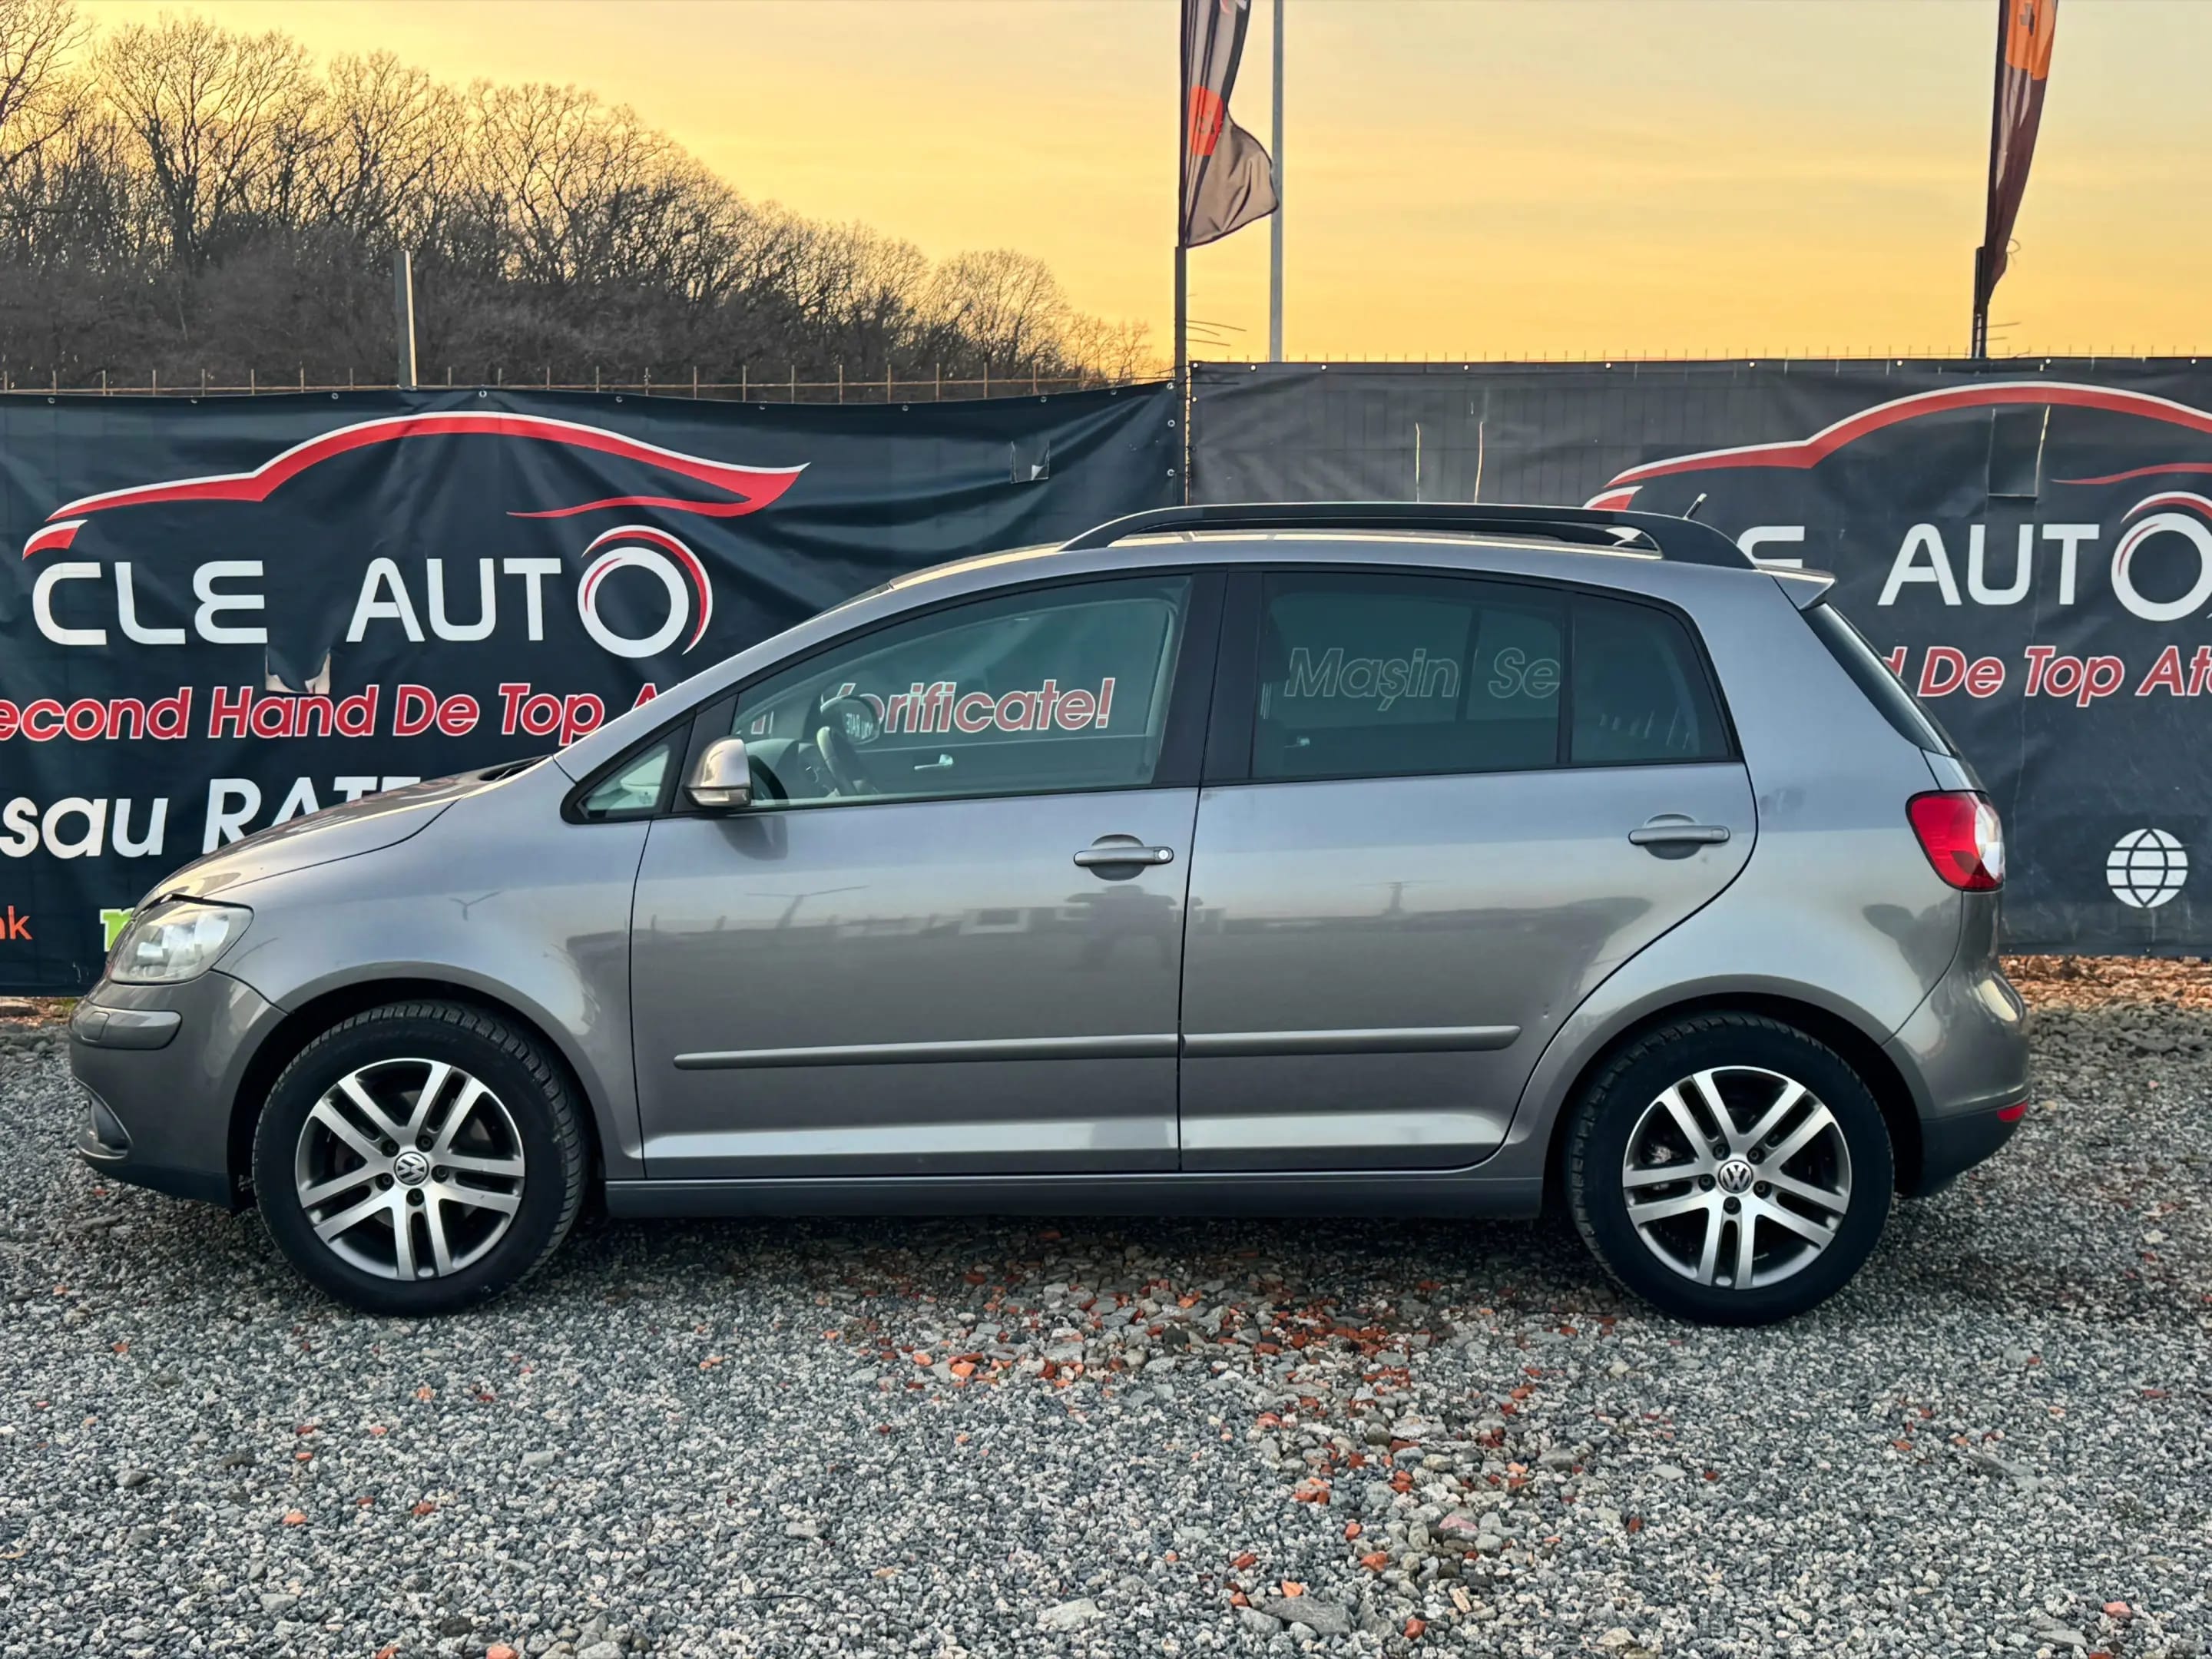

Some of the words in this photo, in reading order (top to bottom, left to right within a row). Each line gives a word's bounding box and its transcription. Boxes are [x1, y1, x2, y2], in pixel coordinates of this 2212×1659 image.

[1878, 512, 2212, 621] AUTO
[32, 561, 267, 646] CLE
[346, 546, 690, 658] AUTO
[1918, 646, 2005, 698] De
[2025, 645, 2125, 707] Top
[2134, 645, 2212, 697] At
[207, 684, 379, 738] Hand
[393, 683, 479, 737] De
[498, 682, 605, 746] Top
[0, 796, 169, 859] sau
